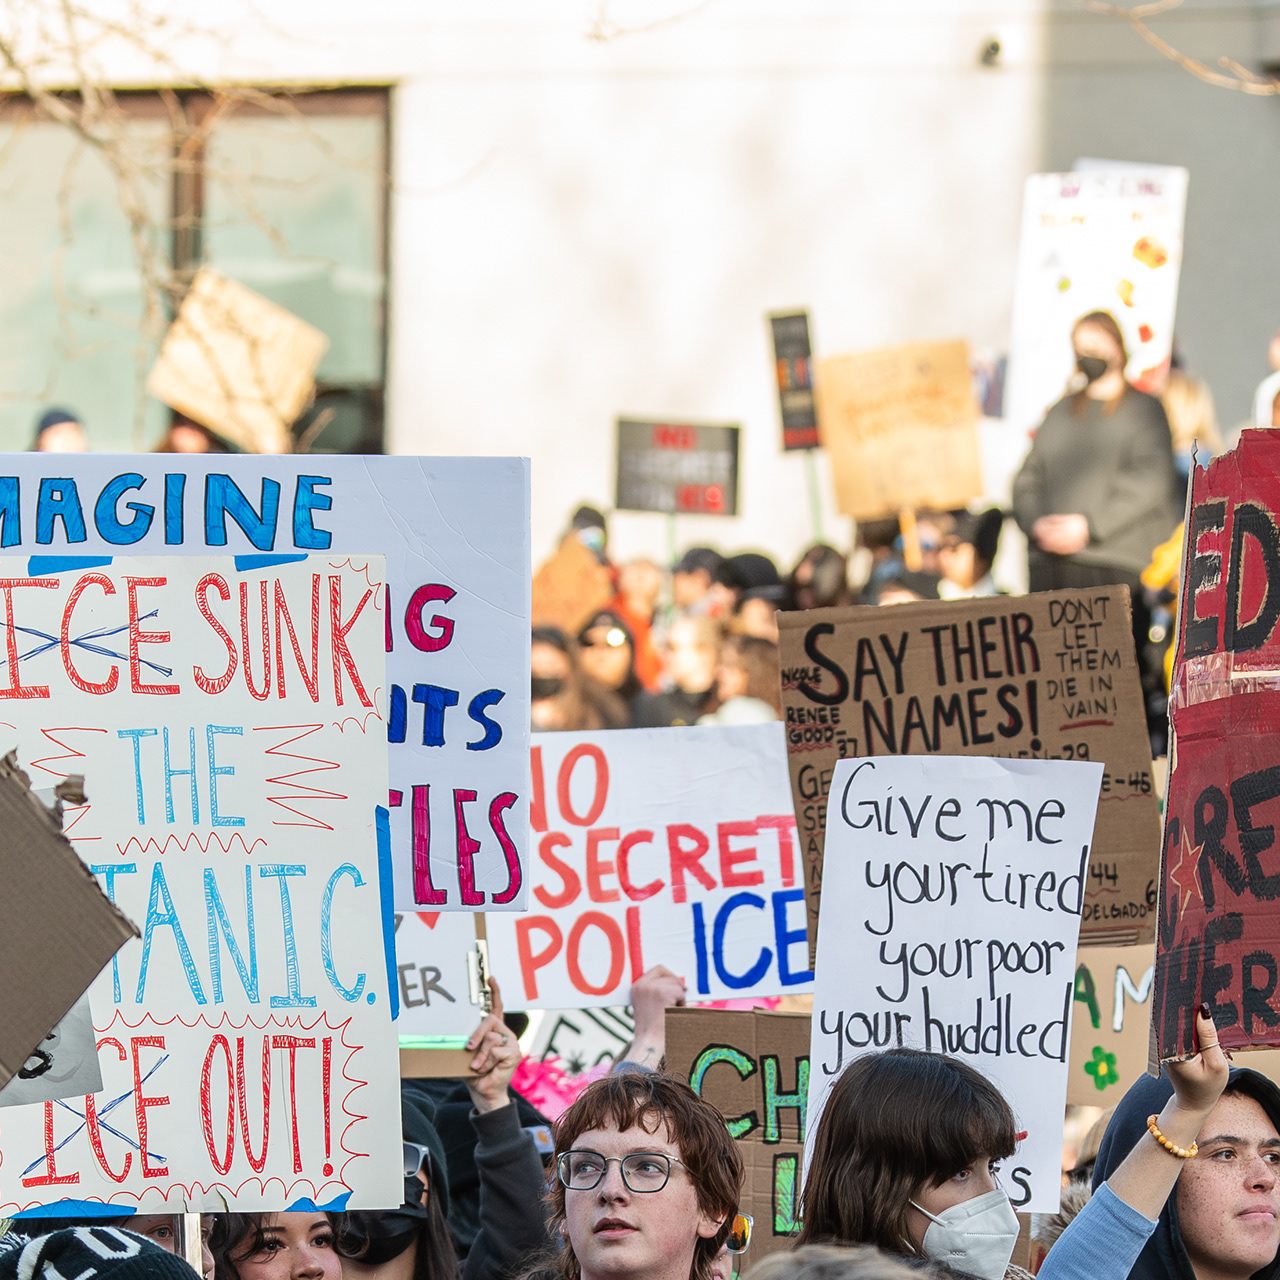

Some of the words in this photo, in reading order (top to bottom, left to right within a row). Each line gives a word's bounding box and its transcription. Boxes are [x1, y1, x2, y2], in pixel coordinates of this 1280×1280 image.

[192, 572, 376, 709] SUNK
[797, 622, 910, 706] SAY
[920, 612, 1042, 687] THEIR
[1054, 649, 1122, 674] THEM
[1062, 621, 1103, 650] LET
[786, 705, 841, 725] RENEE
[861, 679, 1043, 757] NAMES!
[1046, 678, 1078, 701] DIE
[1089, 674, 1114, 692] IN
[1062, 696, 1119, 719] VAIN!
[116, 723, 246, 827] THE
[840, 761, 968, 842] Give
[976, 797, 1065, 845] me
[532, 813, 798, 910] SECRET
[863, 859, 972, 936] your
[973, 842, 1089, 917] tired
[91, 860, 377, 1010] TANIC.
[875, 938, 983, 1003] your
[986, 938, 1066, 1001] poor
[921, 981, 1074, 1064] huddled
[200, 1034, 335, 1178] OUT!
